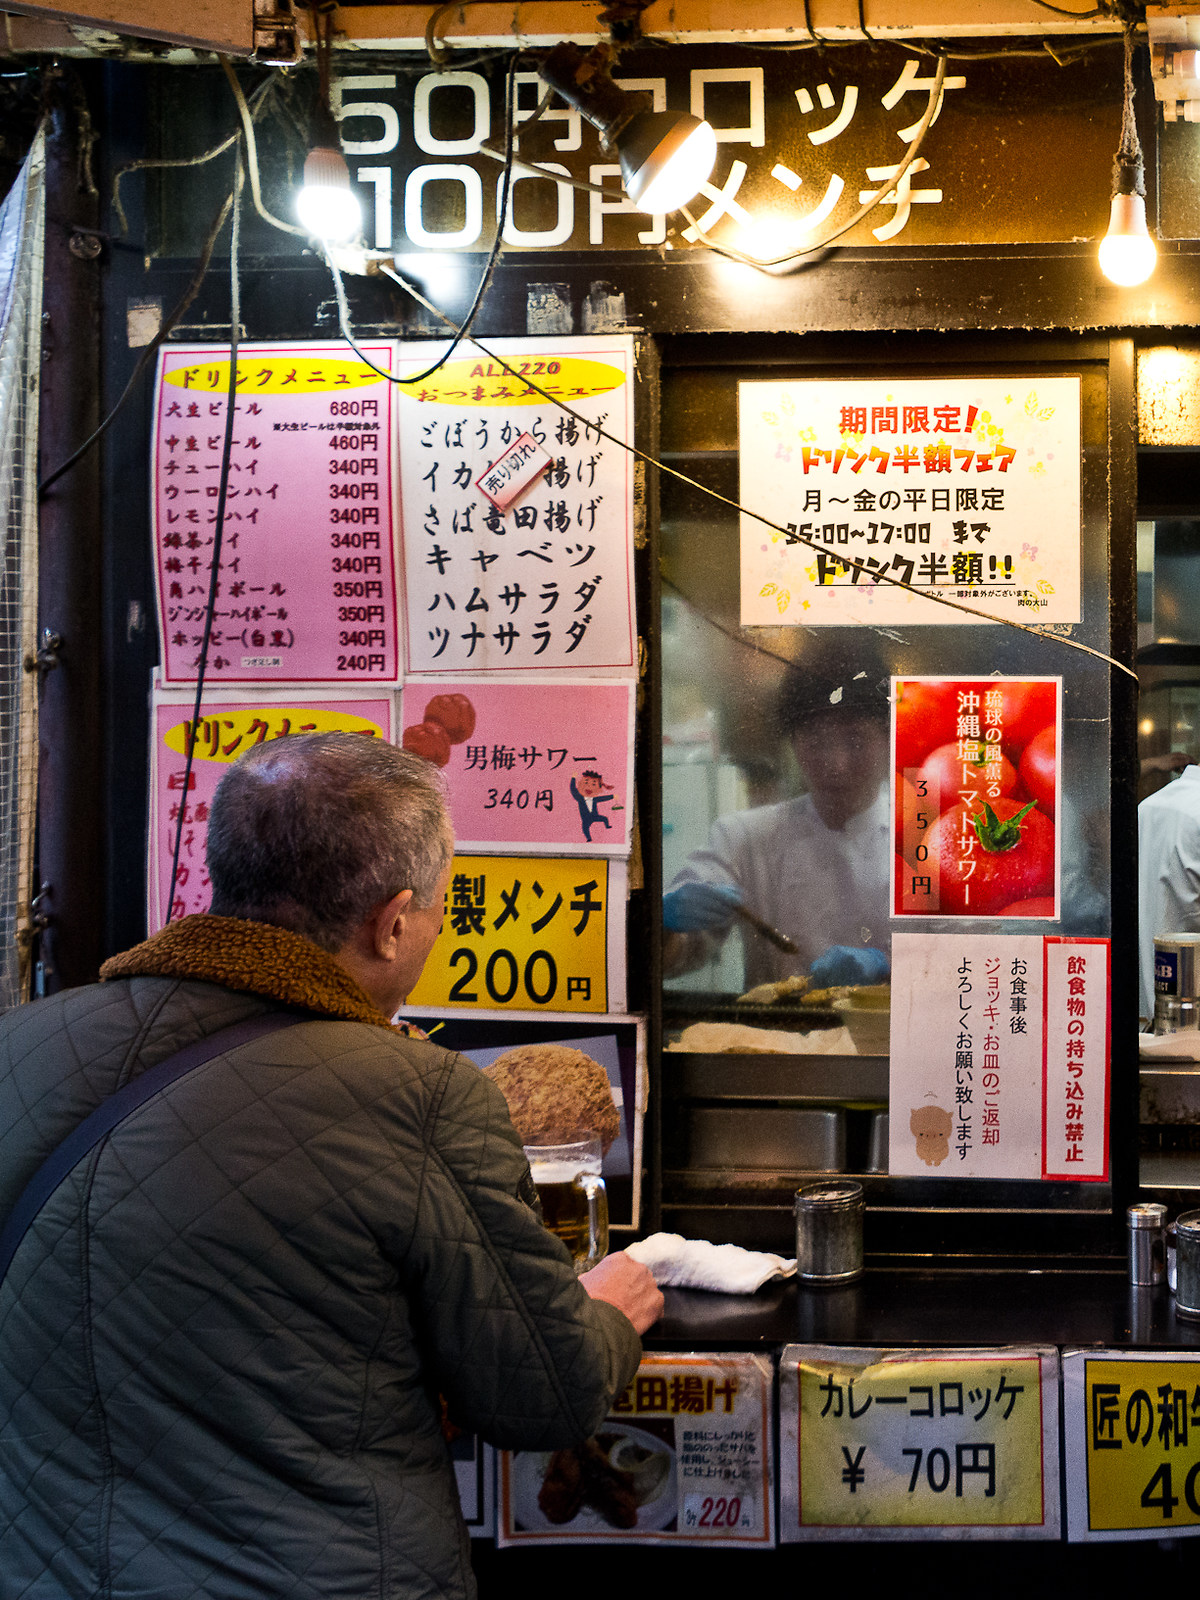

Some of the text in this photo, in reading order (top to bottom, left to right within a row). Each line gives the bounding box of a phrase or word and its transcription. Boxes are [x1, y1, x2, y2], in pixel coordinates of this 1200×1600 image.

[183, 369, 377, 388] ドリンクメニュー
[470, 361, 561, 378] ALL220
[165, 400, 378, 418] 大生ビール 680円
[417, 386, 616, 402] おつまみメニュー
[421, 412, 609, 450] ごぼうから揚げ
[839, 405, 979, 435] 期間限定!
[165, 434, 378, 451] 中生ビール 460円
[164, 459, 378, 475] チューハイ 340円
[423, 452, 603, 492] イカ揚げ
[485, 442, 536, 495] 売り切れ
[801, 443, 1017, 475] ドリンク半額フェア
[165, 483, 378, 500] ウーロンハイ 340円
[802, 487, 1005, 512] 月~金の平日限定
[167, 508, 379, 524] レモンハイ 340円
[422, 495, 603, 536] さば竜田揚げ
[952, 520, 991, 543] まで
[331, 532, 380, 549] 340円
[332, 557, 381, 573] 340円
[427, 542, 596, 576] キャベツ
[816, 552, 1012, 585] ドリンク半額!!
[333, 581, 382, 598] 350円
[427, 575, 603, 614] ハムサラダ
[1018, 599, 1048, 607] 肉の大山
[338, 606, 384, 622] 350円
[339, 630, 385, 647] 340円
[428, 614, 594, 659] ツナサラダ
[337, 654, 385, 671] 240円
[183, 716, 376, 757] ドリンクメー
[985, 690, 1003, 798] 琉球の風薫る
[463, 744, 598, 772] 男梅サワー
[484, 787, 554, 813] 340円
[957, 691, 980, 905] 沖縄塩トマトサワー
[912, 780, 931, 895] 350円
[440, 874, 603, 937] 製メンチ
[448, 948, 591, 1004] 200円
[1009, 958, 1028, 1034] お食事後
[955, 957, 973, 1161] よろしくお願い致します
[981, 957, 1000, 1146] ジョッキ・お皿のご返却
[1065, 956, 1086, 1162] 飲食物の持ち込み禁止
[819, 1373, 1024, 1421] カレーコロッケ
[902, 1442, 996, 1498] 70円
